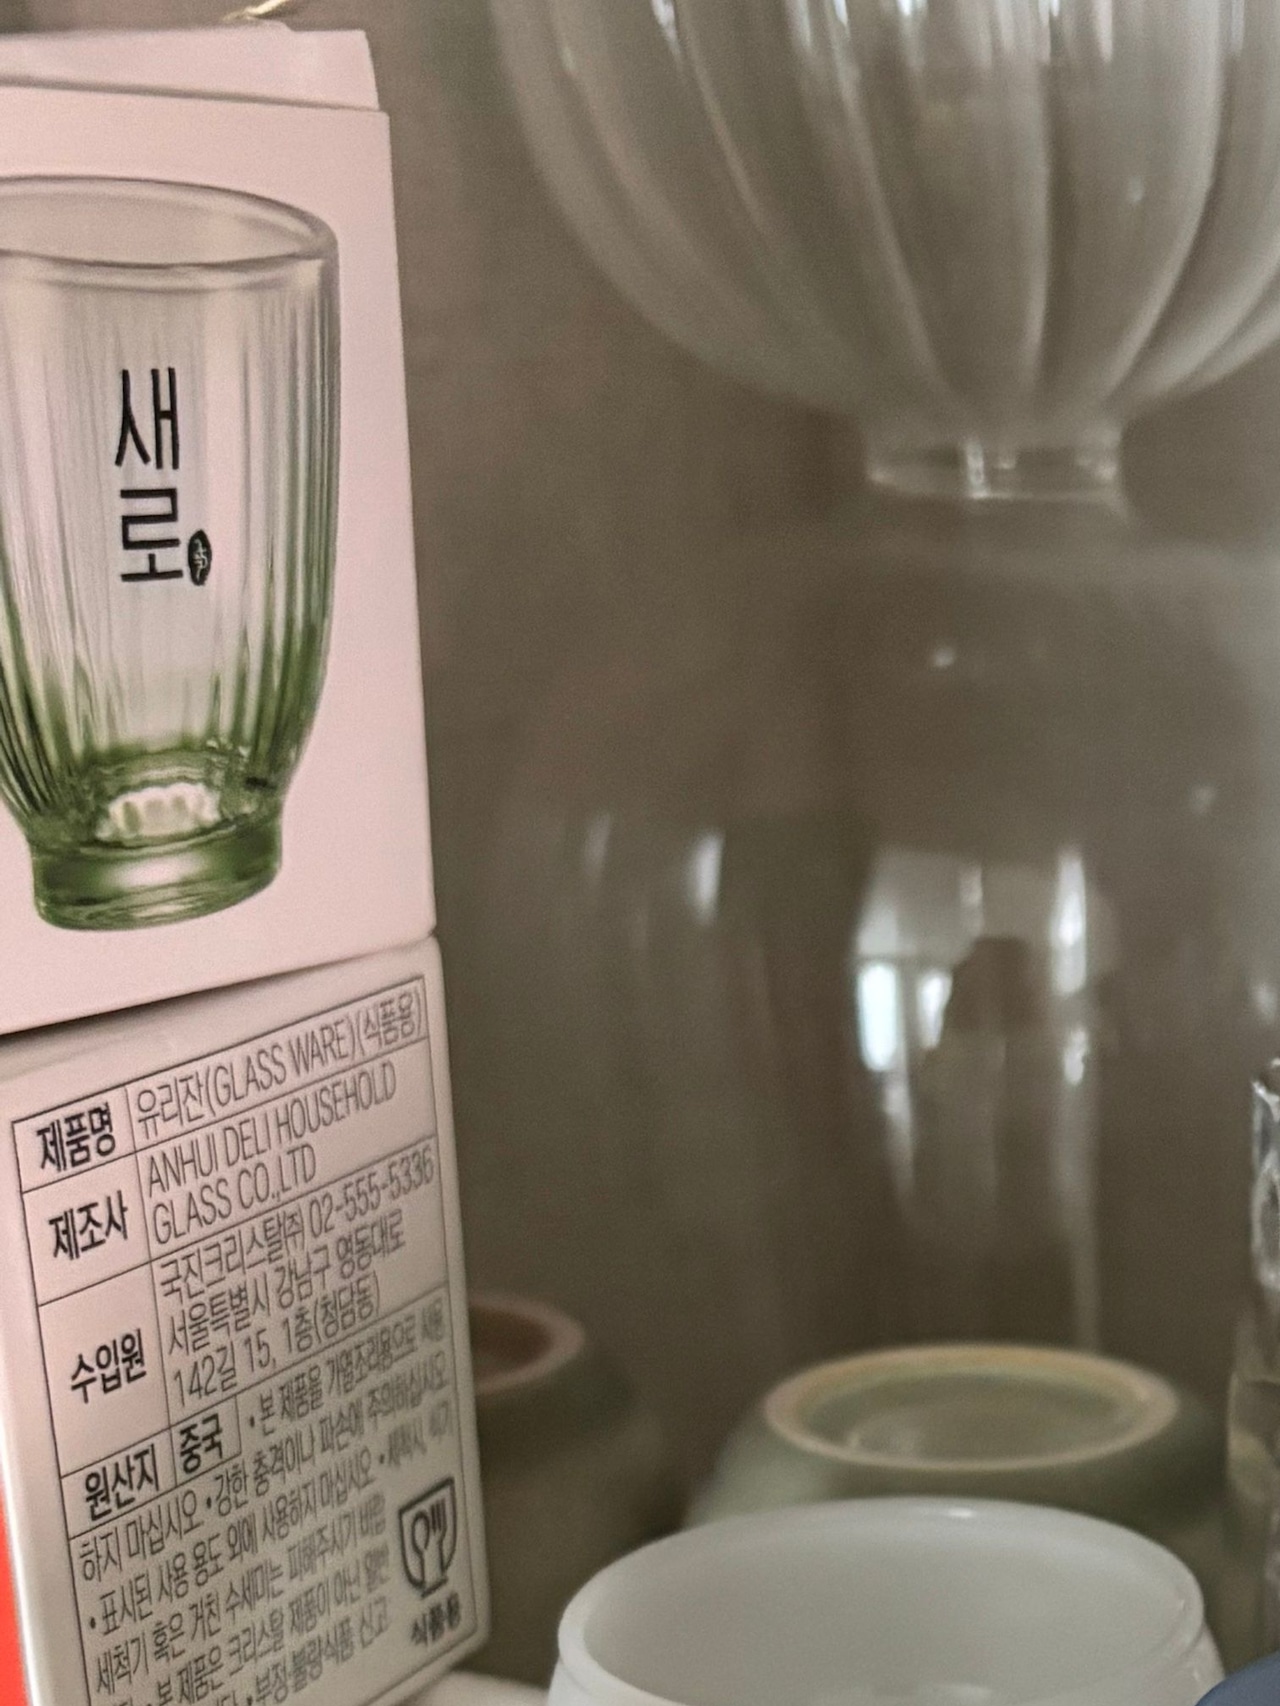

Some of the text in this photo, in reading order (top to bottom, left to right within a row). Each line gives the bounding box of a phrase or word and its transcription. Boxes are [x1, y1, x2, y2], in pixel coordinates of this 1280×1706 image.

[114, 366, 184, 585] 새로
[136, 989, 422, 1139] 유리잔(GLASS WARE)(식품용)
[147, 1060, 397, 1198] ANHUI DELI HOUSEHOLD
[35, 1101, 117, 1173] 제품명
[47, 1189, 129, 1261] 제조사
[152, 1176, 233, 1246] GLASS
[168, 1208, 406, 1356] 서울특별시 강남구 영동대로
[172, 1271, 381, 1408] 142길 15, 1층(청담동)
[70, 1328, 147, 1404] 수입원
[257, 1388, 277, 1438] 본
[78, 1526, 123, 1583] 하지
[252, 1424, 316, 1498] 충격이나
[83, 1443, 161, 1527] 원산지
[177, 1412, 224, 1476] 중국
[95, 1632, 150, 1696] 세척기
[151, 1611, 187, 1664] 혹은
[187, 1590, 222, 1642] 거친
[224, 1559, 284, 1623] 수세미는
[286, 1509, 358, 1581] 피해주시기
[157, 1551, 190, 1604] 사용
[191, 1532, 225, 1588] 용도
[225, 1511, 259, 1563] 외에
[261, 1478, 318, 1543] 사용하지
[176, 1645, 225, 1705] 제품은
[227, 1607, 285, 1677] 크리스탈
[333, 1559, 361, 1607] 아닌
